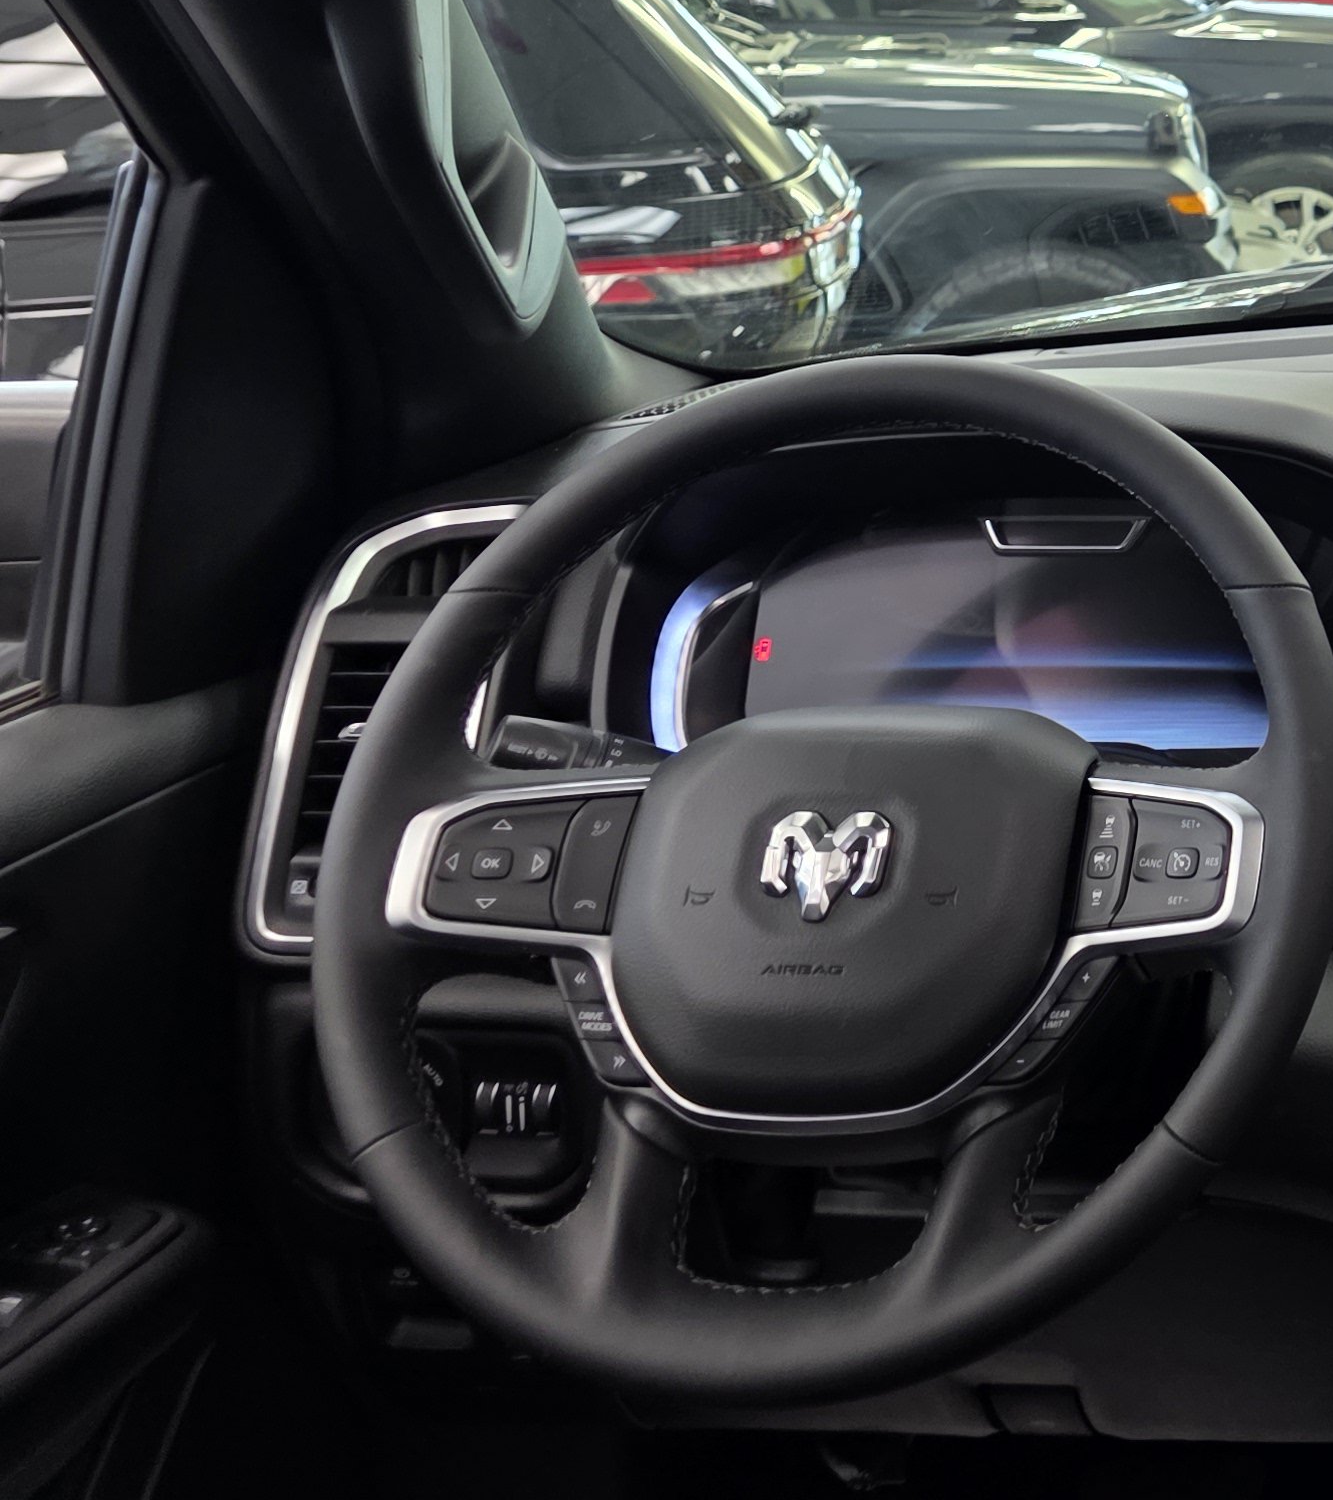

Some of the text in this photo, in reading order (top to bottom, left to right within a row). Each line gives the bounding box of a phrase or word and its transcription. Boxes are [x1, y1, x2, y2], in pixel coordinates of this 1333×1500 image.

[481, 857, 501, 869] OK
[1139, 858, 1163, 869] CANC
[1205, 857, 1219, 867] RES
[761, 964, 845, 976] AIRBAG
[578, 1011, 605, 1021] DRIVE
[1049, 1009, 1071, 1020] GEAR
[581, 1021, 612, 1032] MODES
[1042, 1019, 1063, 1030] LIMIT
